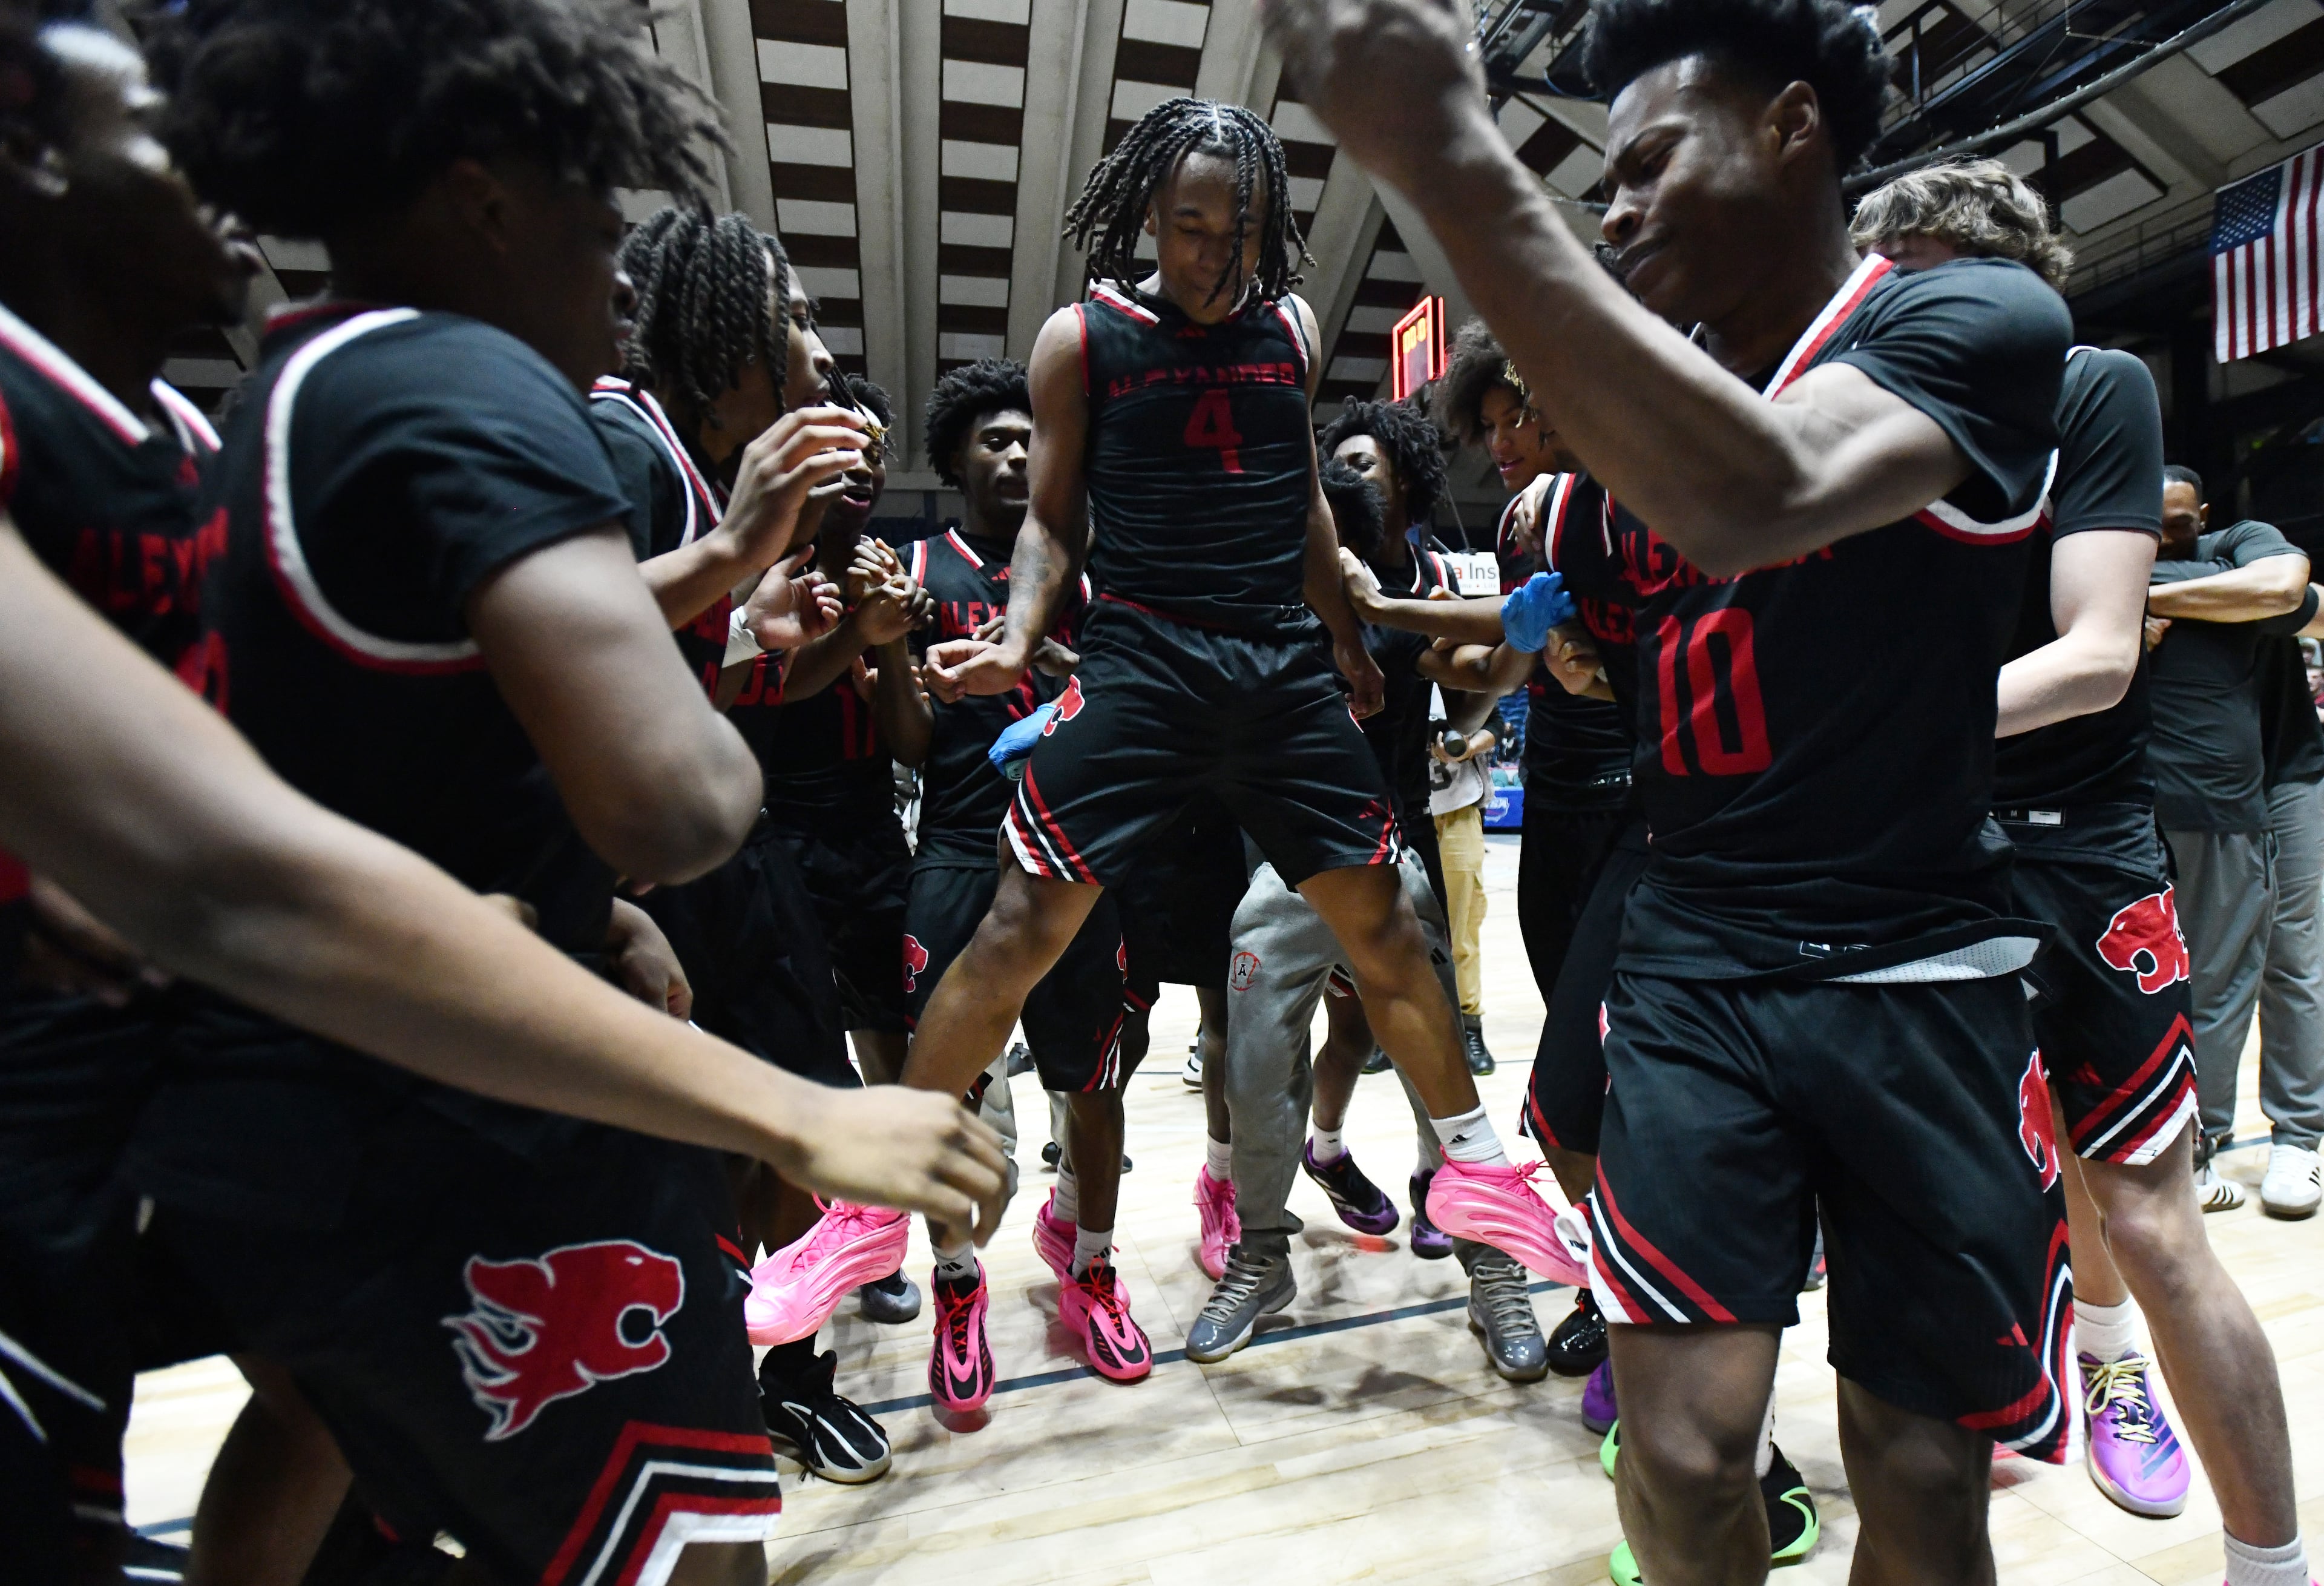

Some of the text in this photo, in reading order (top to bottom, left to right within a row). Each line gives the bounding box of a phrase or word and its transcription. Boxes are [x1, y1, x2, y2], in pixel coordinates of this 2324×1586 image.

[1184, 388, 1245, 474] 4
[1469, 562, 1497, 579] Ins
[1655, 607, 1773, 777] 10
[1238, 964, 1247, 976] A
